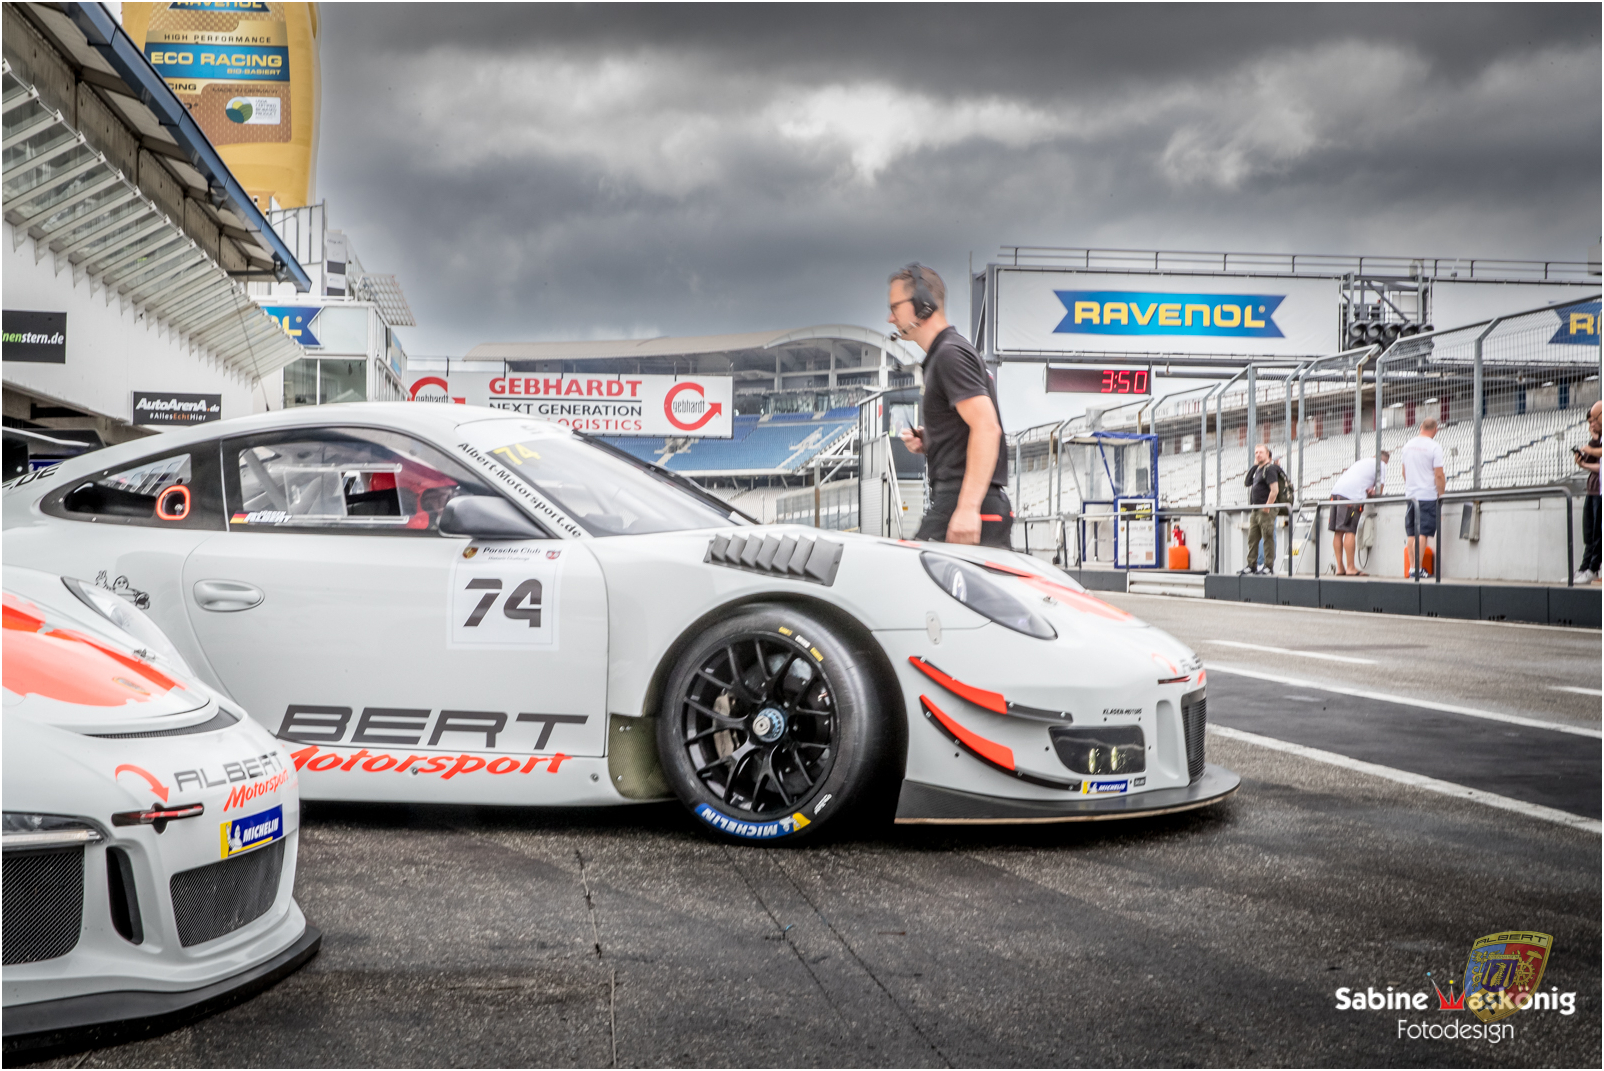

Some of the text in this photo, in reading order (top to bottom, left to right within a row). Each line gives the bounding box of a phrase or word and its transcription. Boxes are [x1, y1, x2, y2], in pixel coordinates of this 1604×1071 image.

[194, 35, 271, 43] PERFORMANCE
[151, 52, 282, 67] ECO RACING
[1074, 301, 1266, 328] RAVENOL
[1570, 312, 1600, 335] R
[489, 377, 642, 397] GEBHARDT
[1101, 370, 1147, 393] 3:50
[149, 412, 206, 421] #AllesEchtHier
[538, 403, 642, 416] GENERATION
[672, 399, 705, 414] gebhardt
[547, 418, 642, 431] OGISTICS
[493, 443, 541, 465] 74
[458, 442, 581, 538] Albert-Motorsport.de
[483, 547, 519, 555] Porsche
[463, 578, 543, 628] 74
[276, 704, 589, 750] BERT
[173, 751, 283, 792] ALBERT
[1098, 783, 1127, 791] MICHELIN
[243, 817, 280, 843] MICHELIN
[701, 808, 779, 837] MICHELIN
